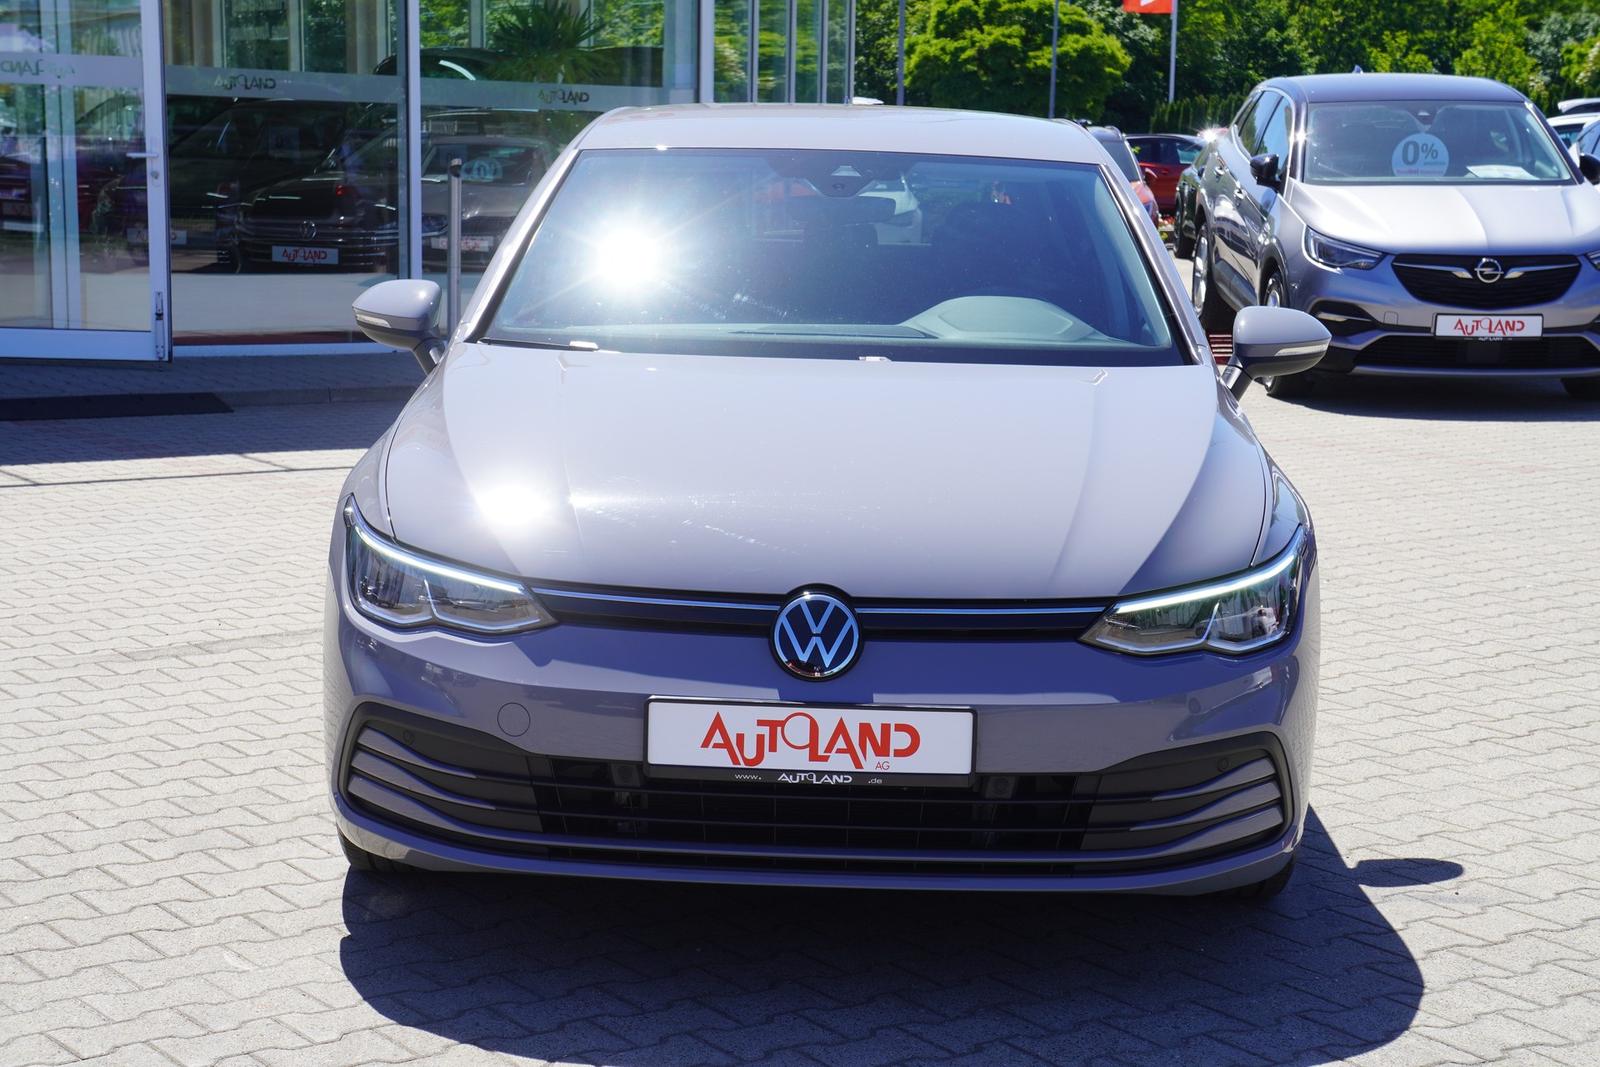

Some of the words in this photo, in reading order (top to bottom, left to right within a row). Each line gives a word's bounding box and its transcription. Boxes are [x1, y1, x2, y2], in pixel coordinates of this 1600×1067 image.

[1402, 141, 1438, 165] 0%
[1454, 317, 1525, 336] AUTOLAND
[700, 711, 921, 770] AUTOLAND
[875, 761, 890, 770] AG
[777, 772, 853, 785] AUTOLAND
